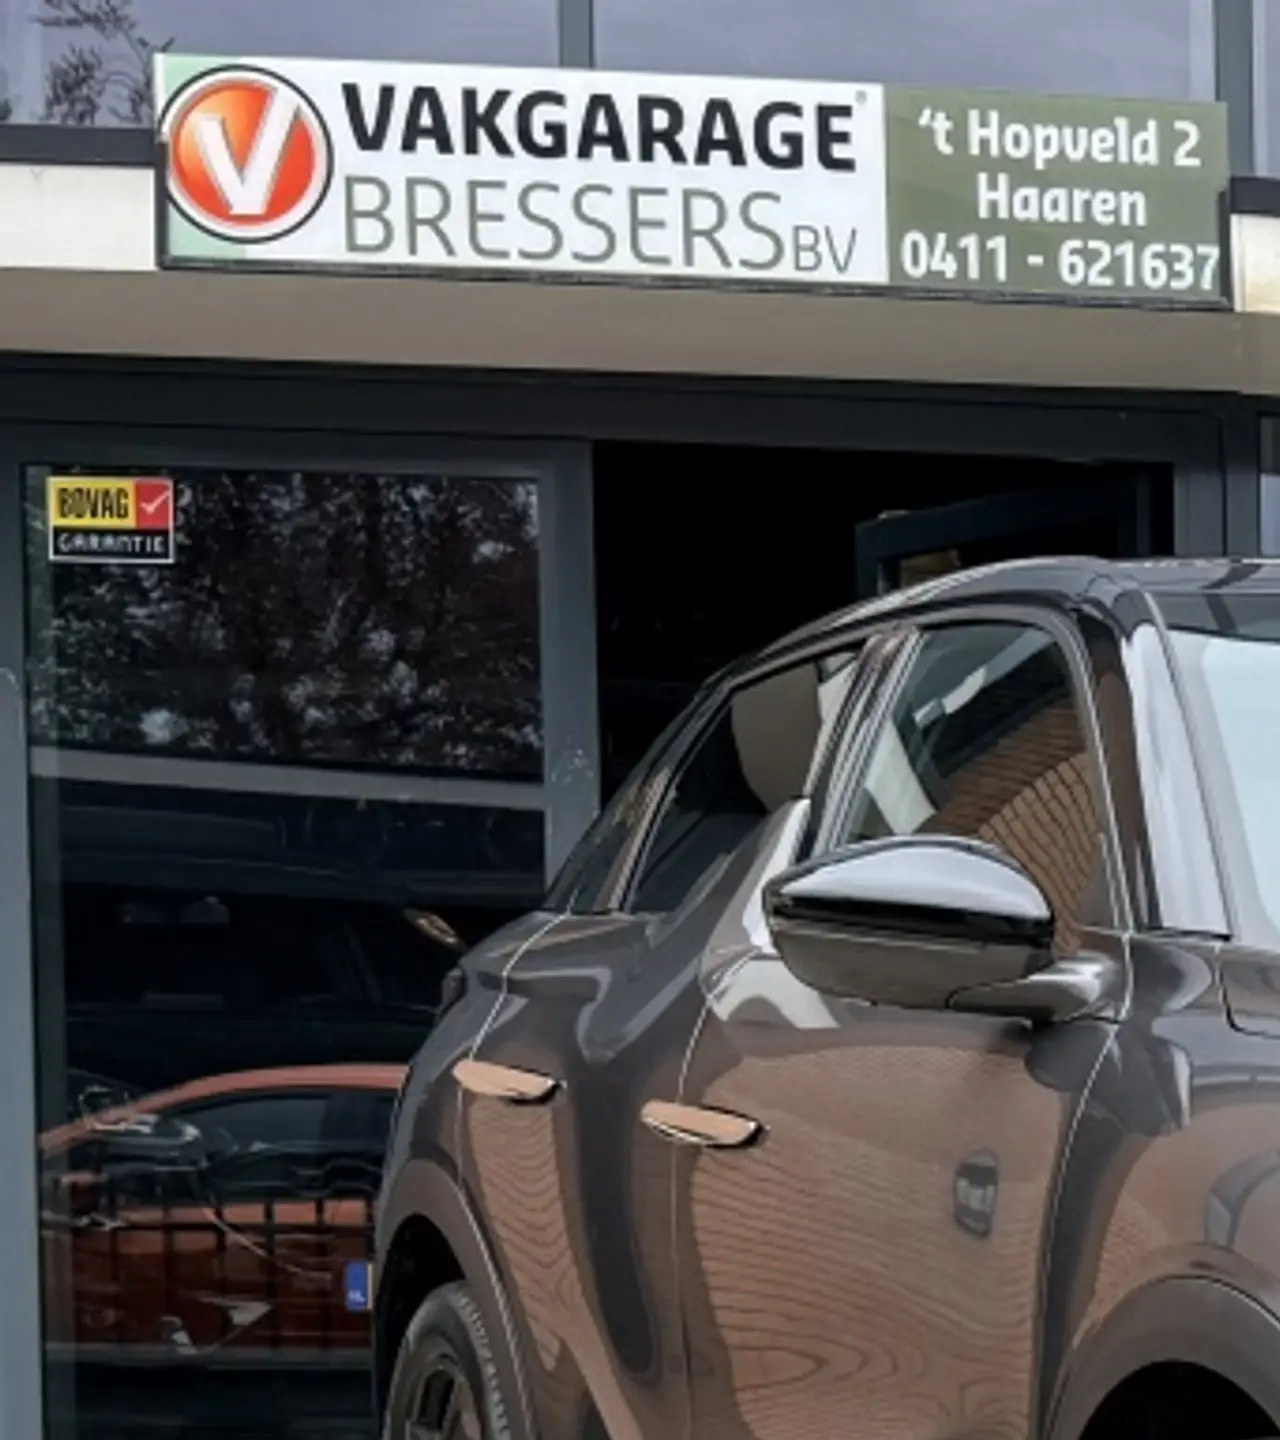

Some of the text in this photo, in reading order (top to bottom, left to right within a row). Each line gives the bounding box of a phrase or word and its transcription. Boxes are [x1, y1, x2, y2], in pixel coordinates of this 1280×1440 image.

[341, 82, 856, 173] VAKGARAGE
[967, 108, 1159, 170] Hopveld
[1172, 120, 1201, 167] 2
[344, 174, 857, 273] BRESSERS BV
[976, 172, 1147, 227] Haaren
[901, 230, 1007, 282] 0411
[1057, 239, 1220, 290] 621637
[58, 487, 129, 519] BOVAG
